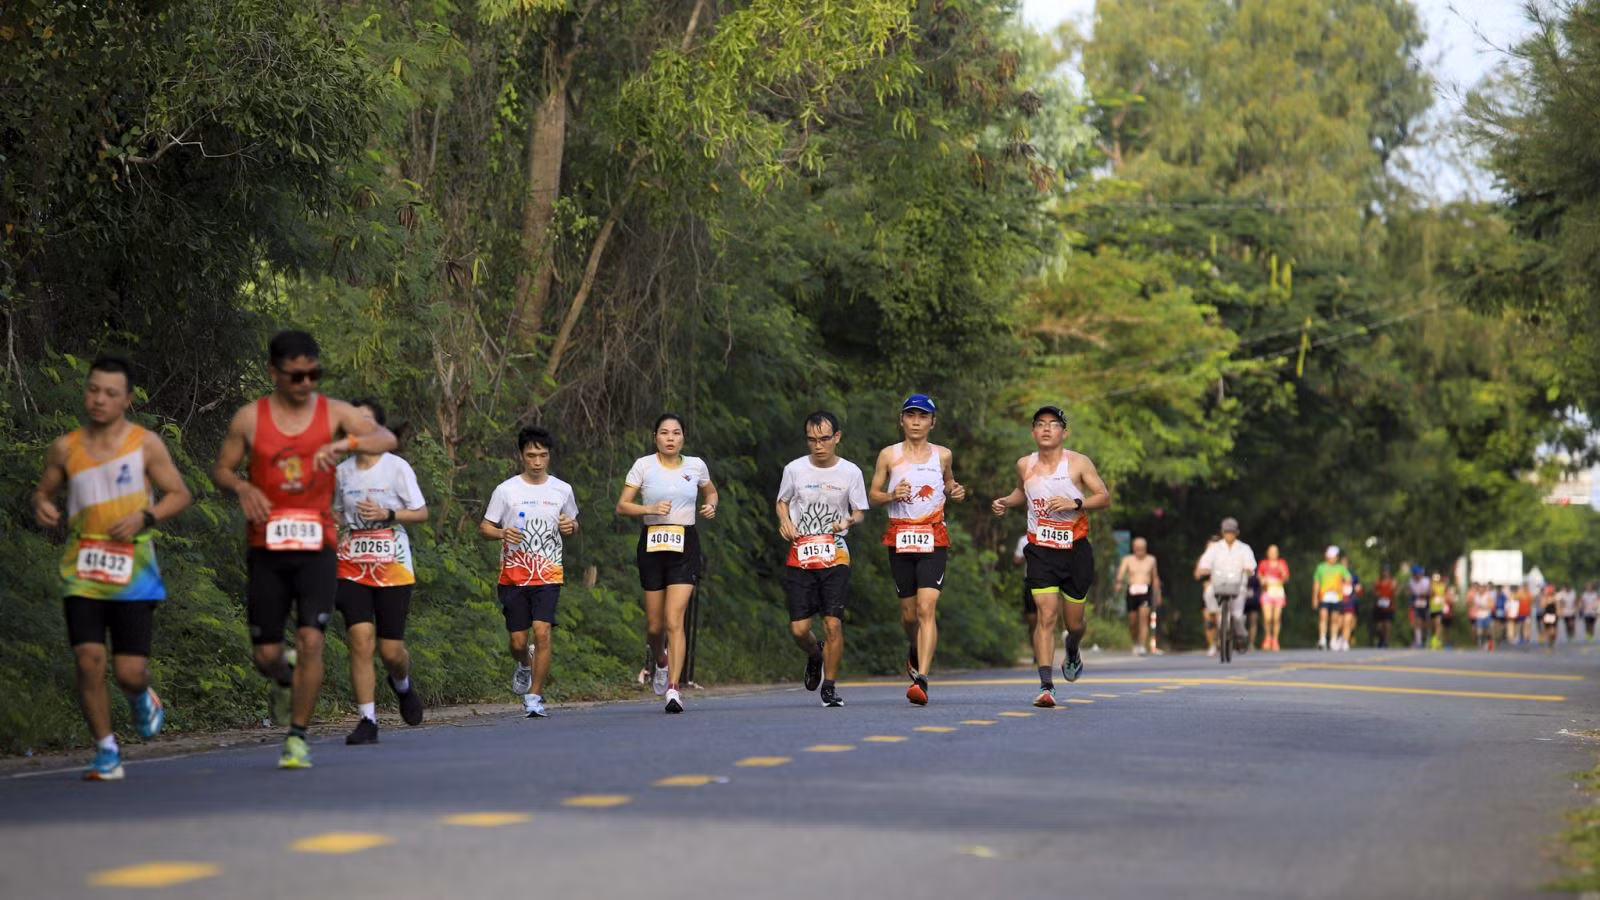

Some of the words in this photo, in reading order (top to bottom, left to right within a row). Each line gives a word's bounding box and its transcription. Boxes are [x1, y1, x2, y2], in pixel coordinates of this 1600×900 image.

[650, 533, 682, 544] 40049
[901, 534, 929, 545] 41142
[1041, 528, 1069, 541] 41456
[354, 541, 390, 553] 20265
[803, 544, 830, 556] 41574
[85, 551, 127, 571] 41432
